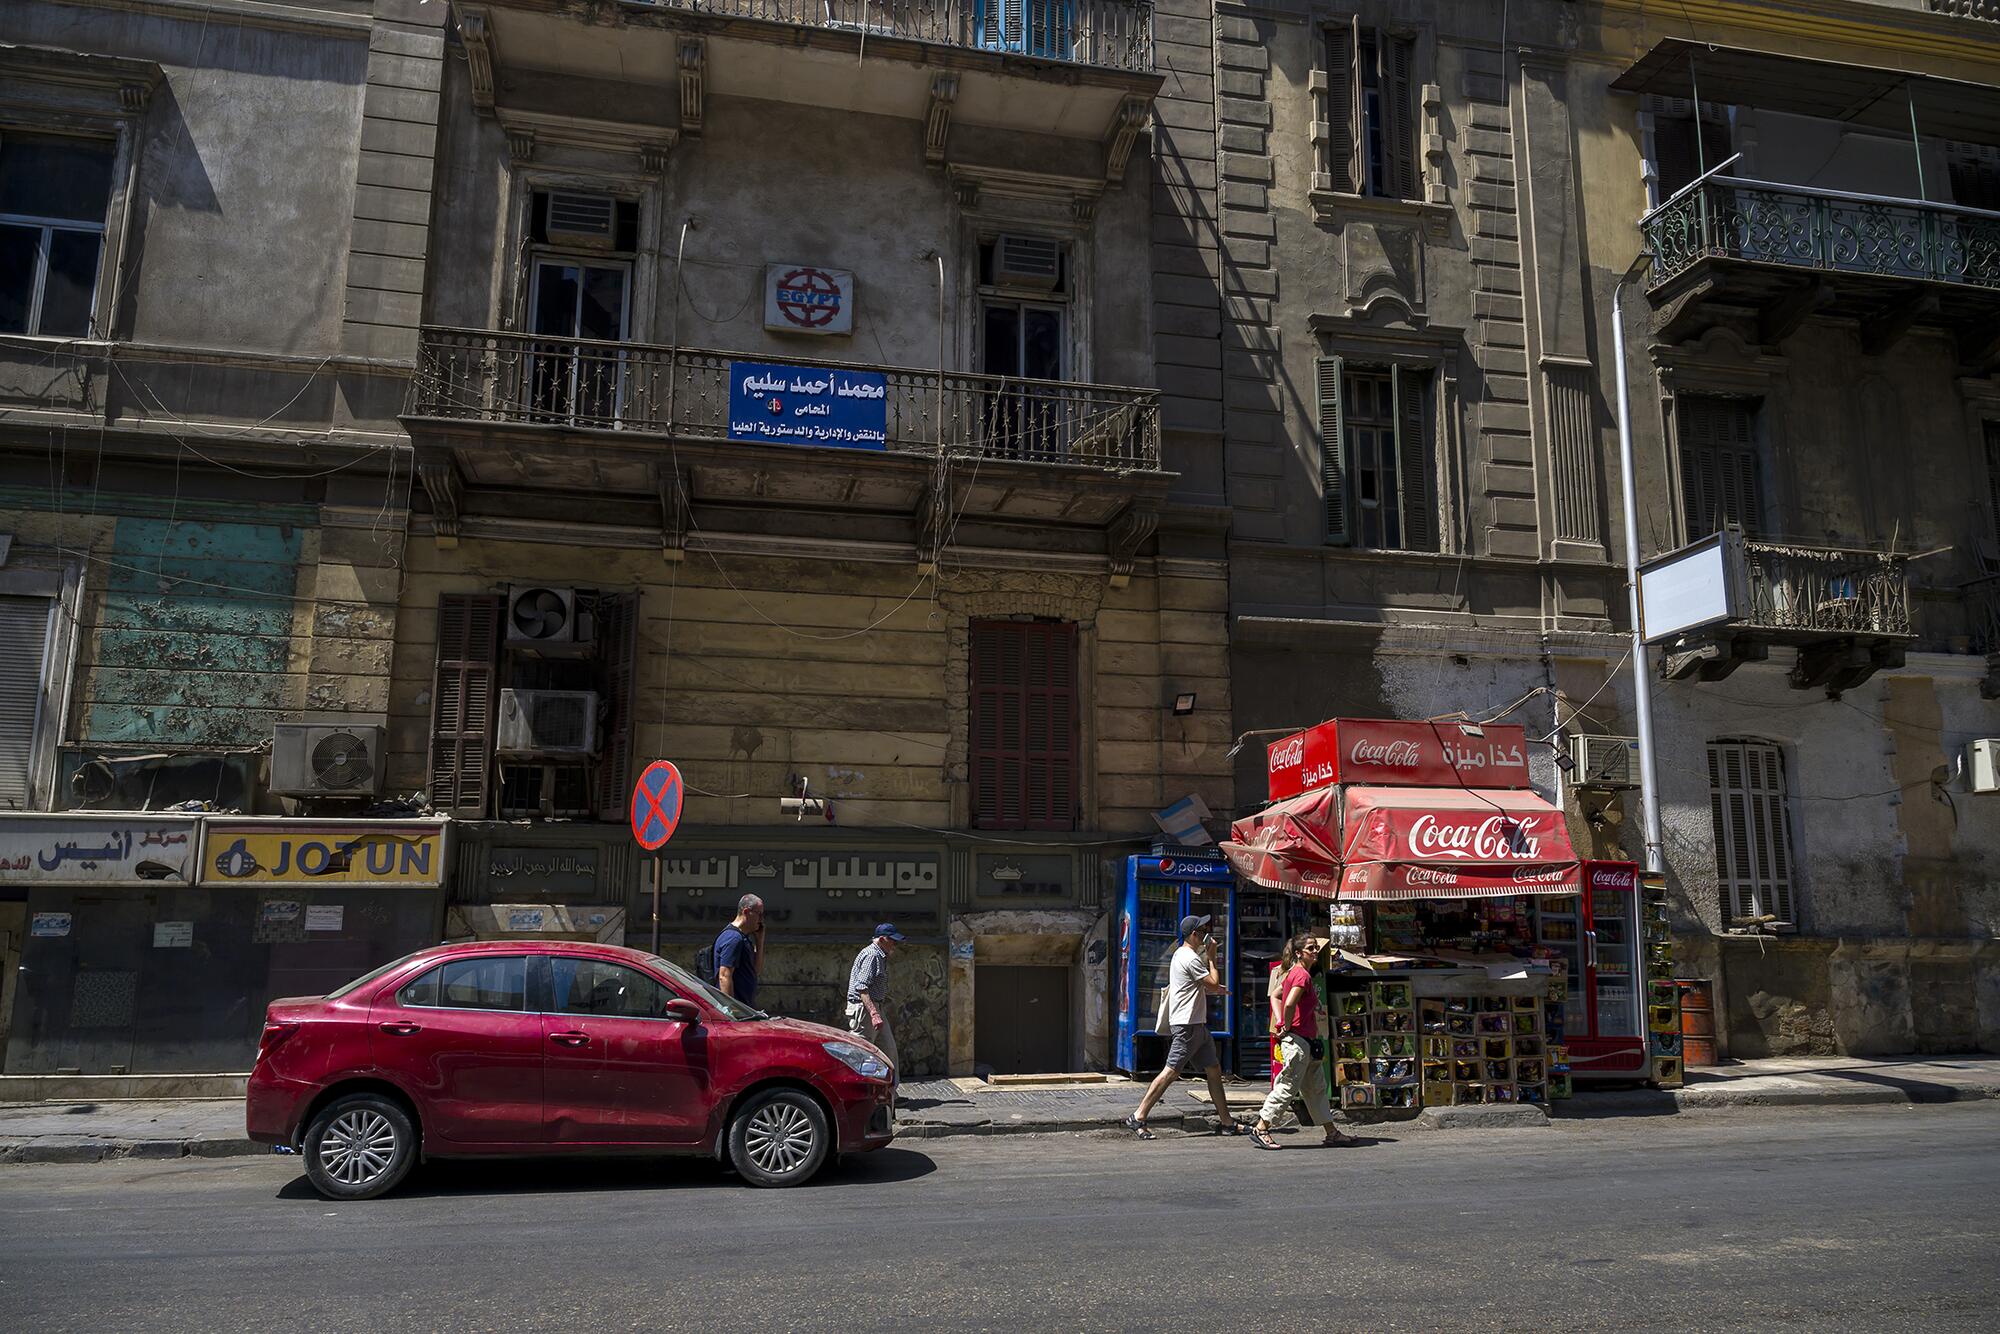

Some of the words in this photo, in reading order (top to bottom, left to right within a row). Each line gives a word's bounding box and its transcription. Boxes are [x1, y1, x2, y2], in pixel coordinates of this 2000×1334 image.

[776, 288, 842, 306] EGYPT
[743, 372, 786, 398] سليم
[790, 373, 834, 396] أحمد
[838, 379, 885, 398] محمد
[795, 404, 830, 416] المحامى
[732, 421, 757, 434] العليا
[814, 425, 852, 441] والإدارية
[852, 427, 886, 444] بالنقض
[1270, 738, 1304, 773] Coca-Cola
[1351, 738, 1421, 766] Coca-Cola
[1442, 741, 1484, 771] ميزة
[1490, 744, 1525, 768] كذا
[1302, 768, 1318, 787] ميزة
[1318, 761, 1333, 780] كذا
[139, 828, 188, 848] مركز
[1408, 814, 1543, 859] Coca-Cola
[37, 829, 133, 872] انيس
[524, 857, 559, 877] الرحمن
[560, 857, 576, 874] الله
[640, 855, 739, 896] انيس
[1178, 862, 1214, 875] pepsi
[1512, 864, 1564, 884] Coca-Cola
[1406, 866, 1459, 886] Coca-Cola
[1593, 870, 1632, 887] Coca-Cola
